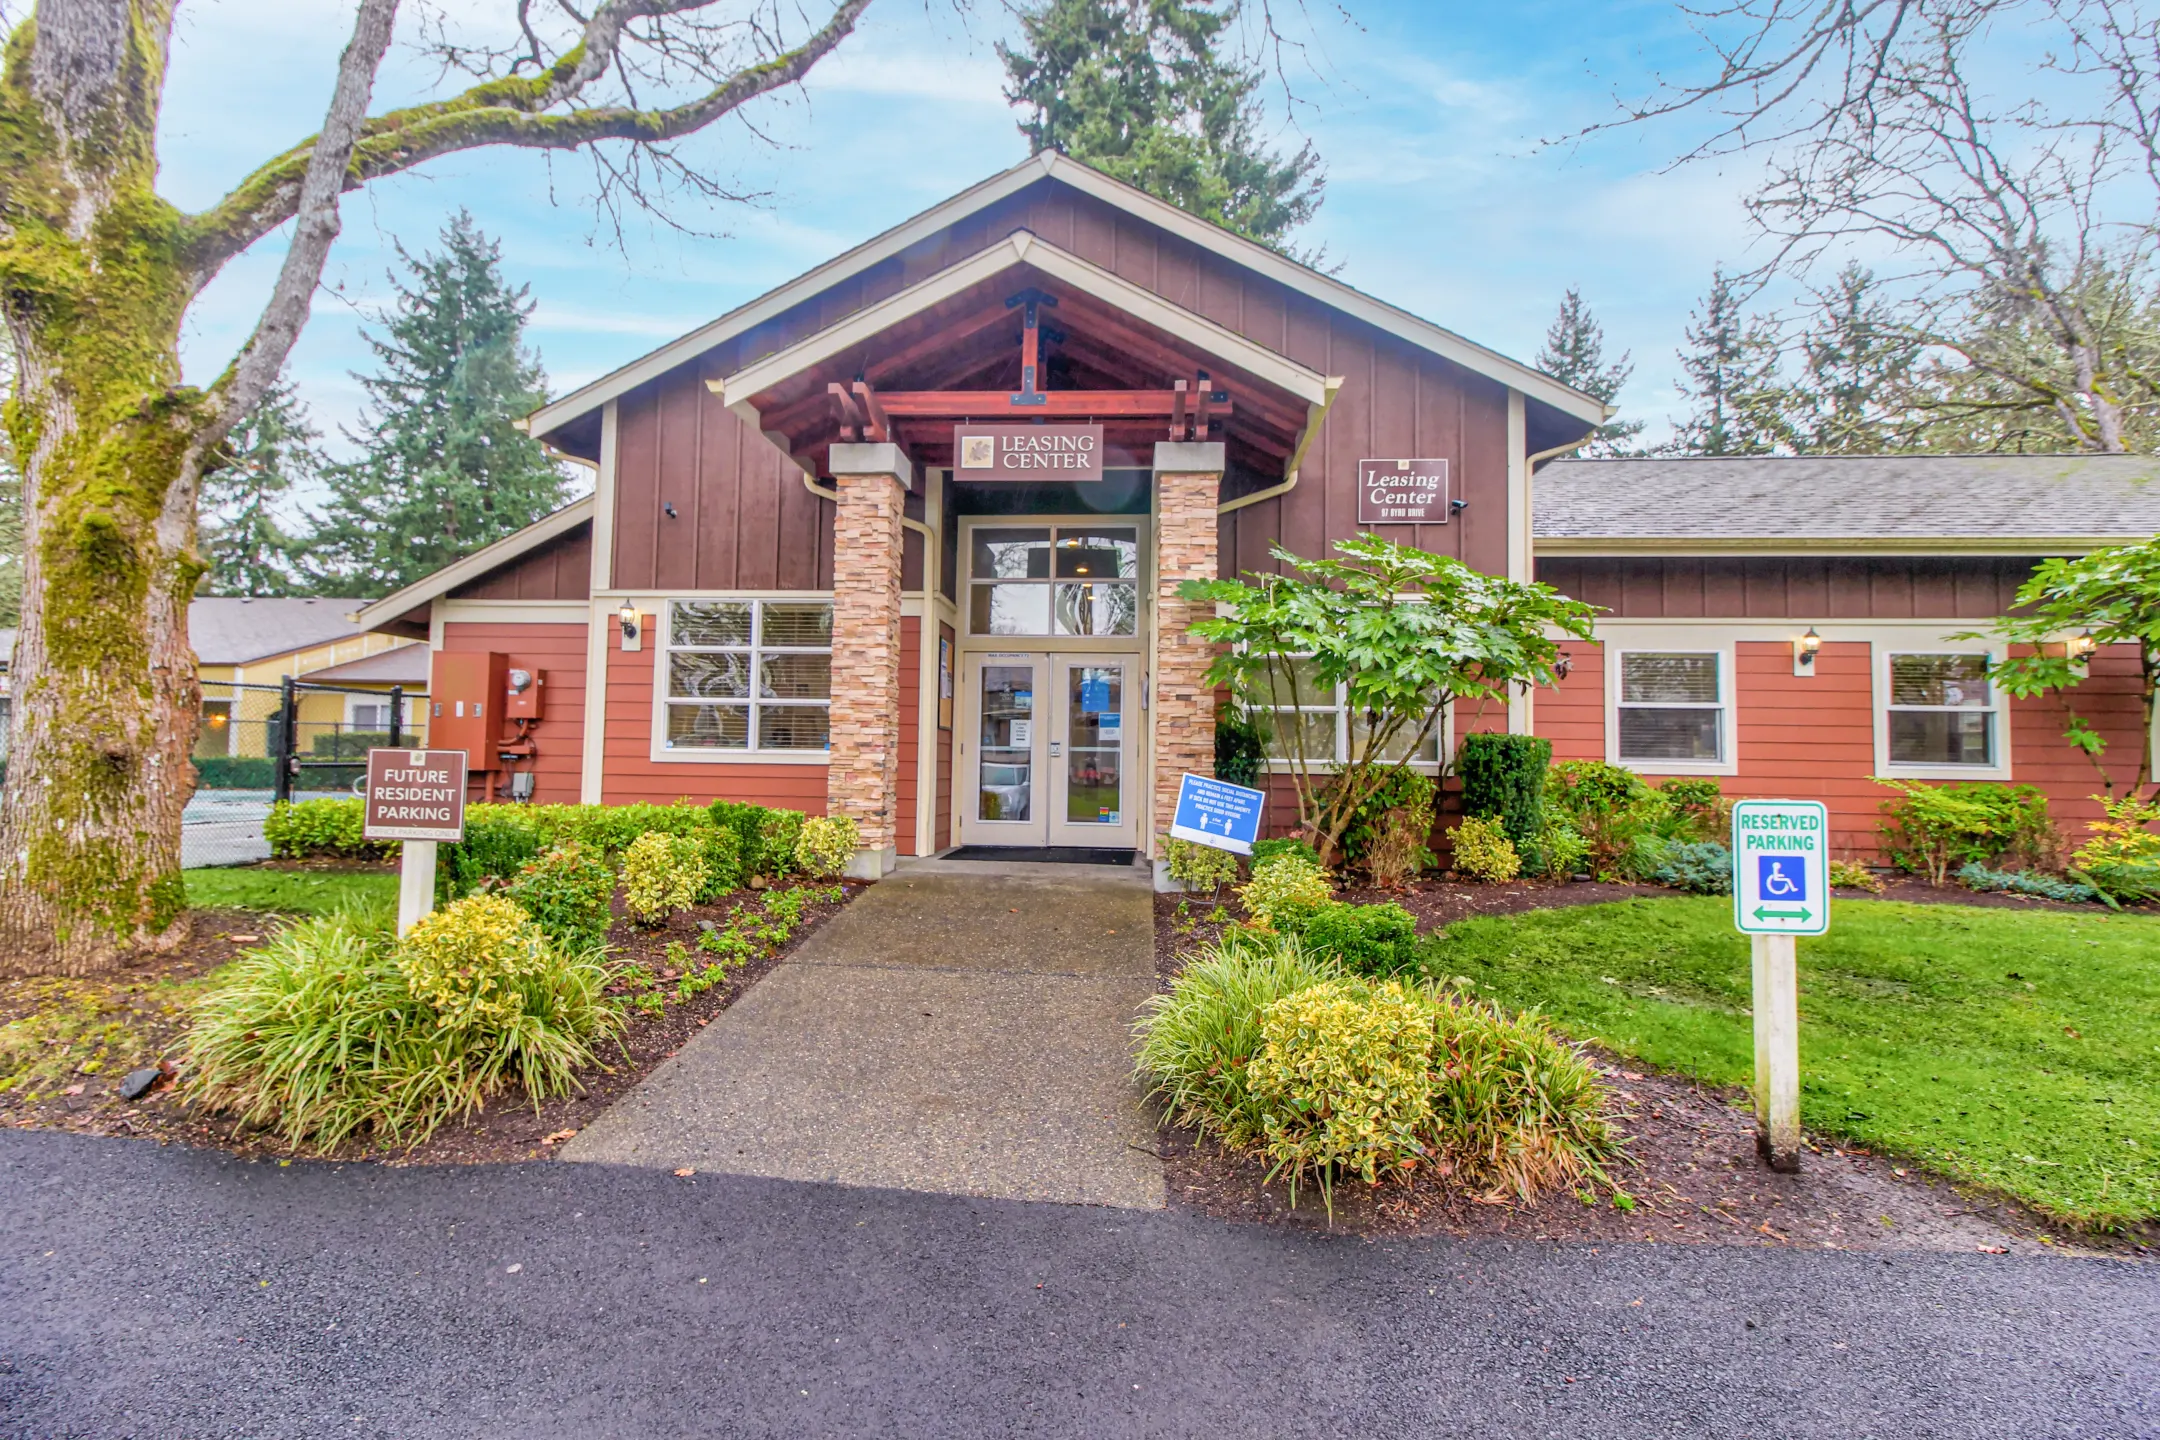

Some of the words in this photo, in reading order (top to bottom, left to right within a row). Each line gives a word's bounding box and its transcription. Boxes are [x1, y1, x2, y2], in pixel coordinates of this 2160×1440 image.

[1002, 436, 1095, 452] LEASING
[1003, 453, 1091, 468] CENTER
[1366, 470, 1440, 490] Leasing
[1370, 488, 1436, 504] Center
[1408, 508, 1426, 518] DRIVE
[384, 769, 448, 784] FUTURE
[374, 786, 456, 802] RESIDENT
[1188, 779, 1203, 787] PLEASE
[1203, 782, 1221, 791] PRACTICE
[1222, 787, 1235, 795] SOCIAL
[377, 806, 450, 821] PARKING
[1741, 814, 1819, 830] RESERVED
[398, 828, 434, 836] PARKING
[1747, 834, 1814, 850] PARKING
